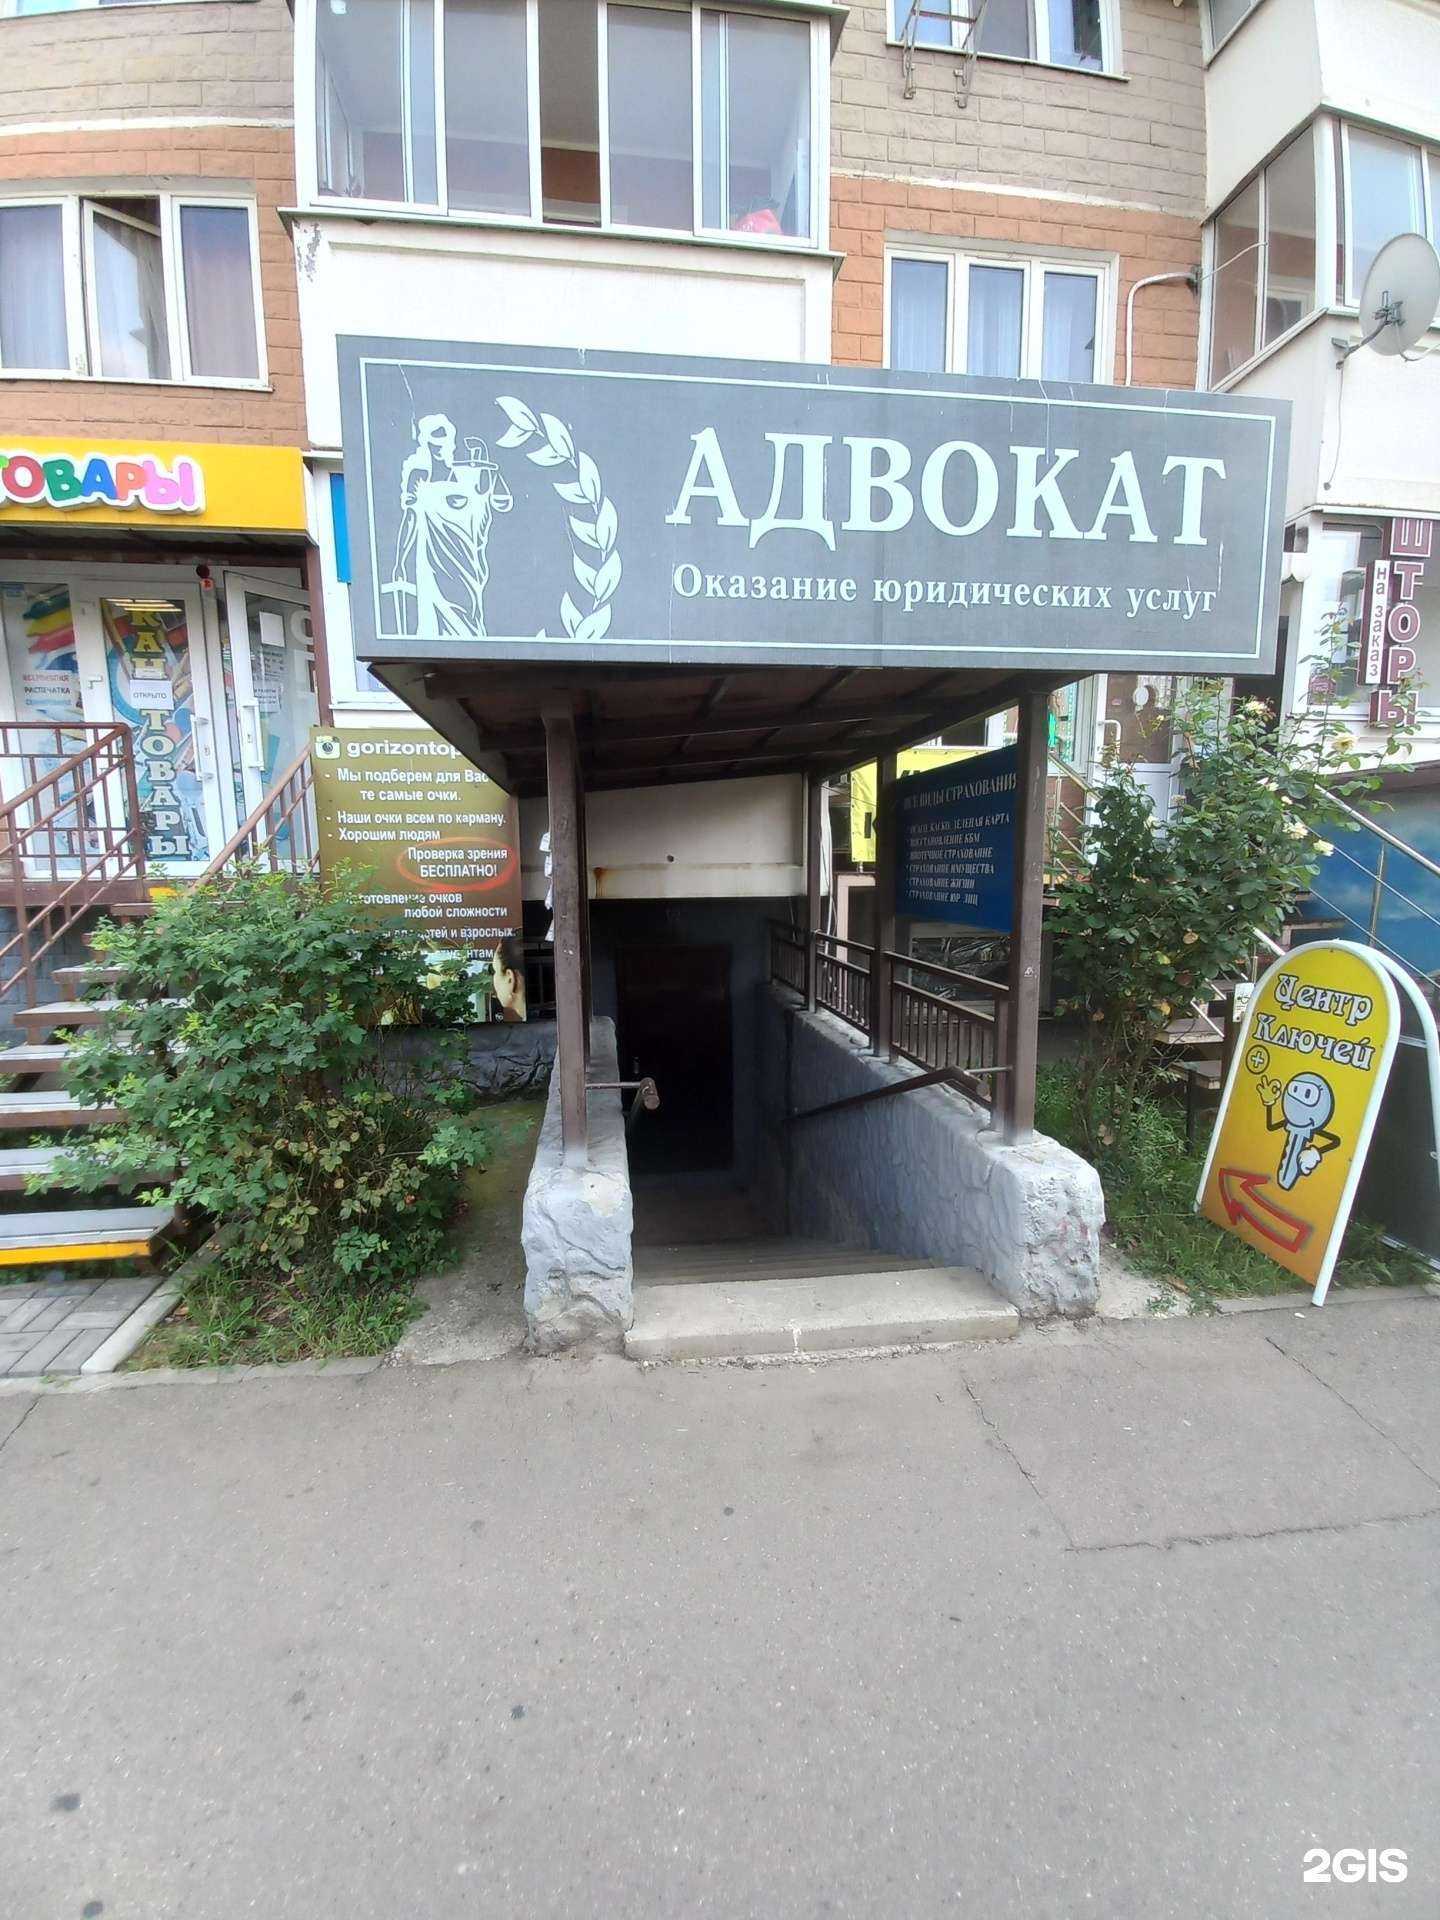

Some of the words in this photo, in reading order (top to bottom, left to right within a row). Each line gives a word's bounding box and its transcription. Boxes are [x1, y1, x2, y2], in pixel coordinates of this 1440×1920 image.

[0, 455, 196, 507] ОВАРЫ
[665, 427, 1226, 551] АДВОКАТ
[673, 563, 857, 601] Оказание
[872, 576, 1112, 612] юридических
[1127, 585, 1217, 619] услуг
[1377, 518, 1432, 727] ШТОРЫ
[337, 768, 361, 782] Мы
[365, 768, 433, 784] подберем
[436, 772, 461, 784] для
[464, 769, 489, 782] Вас
[360, 790, 375, 800] те
[379, 790, 423, 800] самые
[427, 790, 461, 800] очки.
[337, 811, 371, 823] Наши
[375, 813, 402, 823] очки
[406, 813, 434, 823] всем
[438, 813, 452, 823] по
[456, 813, 506, 826] карману.
[338, 827, 396, 843] Хорошим
[400, 830, 440, 842] людям
[408, 847, 464, 861] Проверка
[467, 849, 507, 861] зрения
[420, 864, 497, 877] БЕСПЛАТНО!
[429, 893, 463, 903] очков
[405, 906, 442, 918] любой
[446, 906, 507, 917] сложности
[1274, 973, 1373, 1026] Центр
[1252, 1012, 1376, 1070] Ключей
